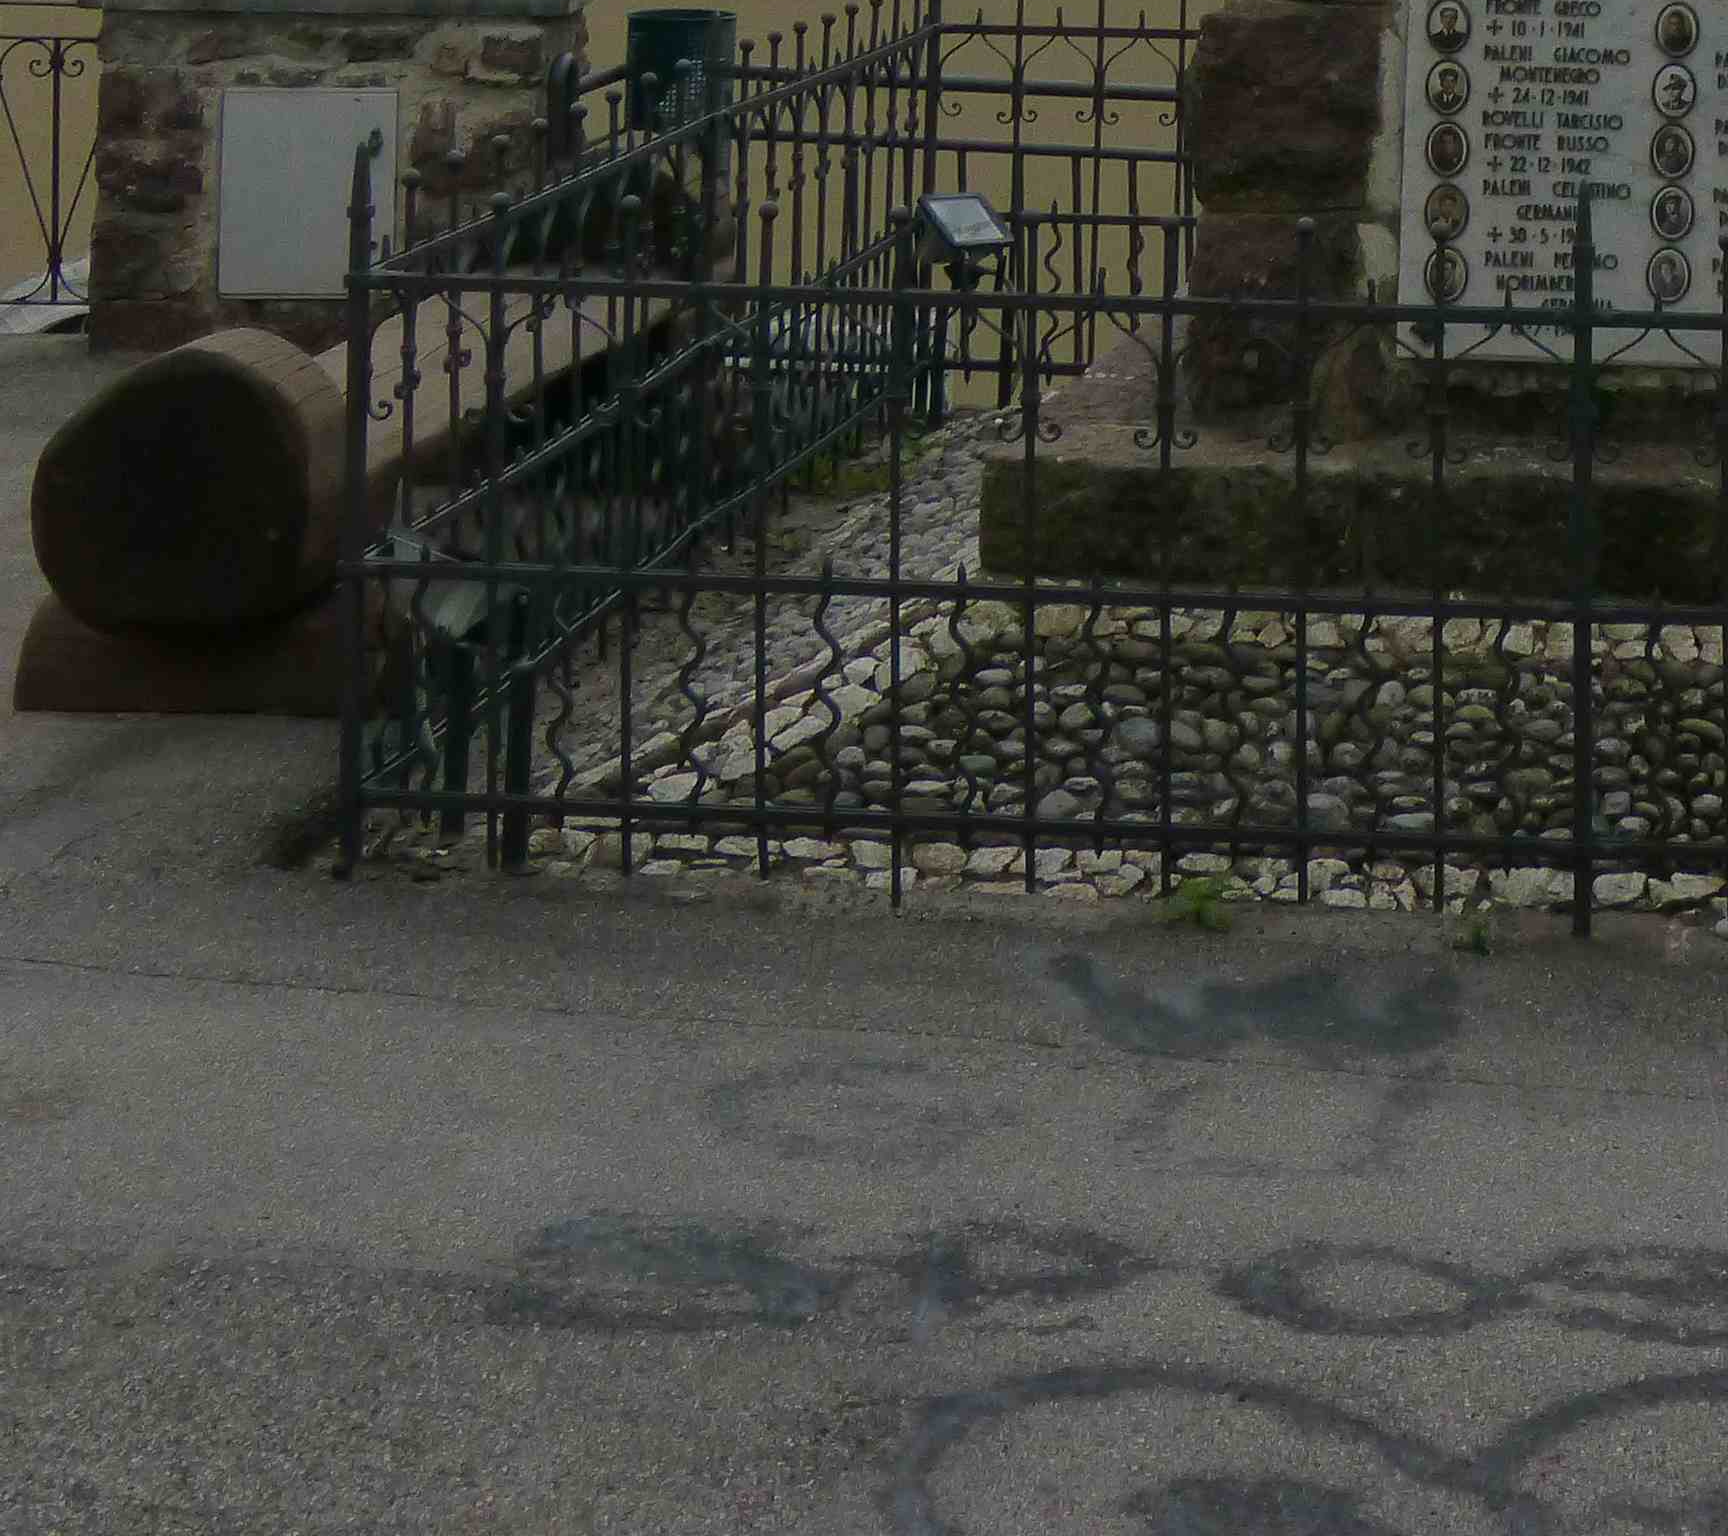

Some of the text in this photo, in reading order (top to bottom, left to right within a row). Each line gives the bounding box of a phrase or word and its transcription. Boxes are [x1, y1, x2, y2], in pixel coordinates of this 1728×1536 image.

[1553, 0, 1602, 17] GRECO
[1483, 45, 1631, 65] PALENI GIACOMO
[1499, 65, 1601, 84] MONTENEGRO
[1482, 110, 1624, 130] ROVELLI TARCISIO
[1484, 133, 1609, 152] FRONTE RUSSO
[1482, 179, 1632, 200] PALENI CELTINO
[1516, 205, 1579, 221] GERMANI
[1484, 250, 1535, 268] PALENI
